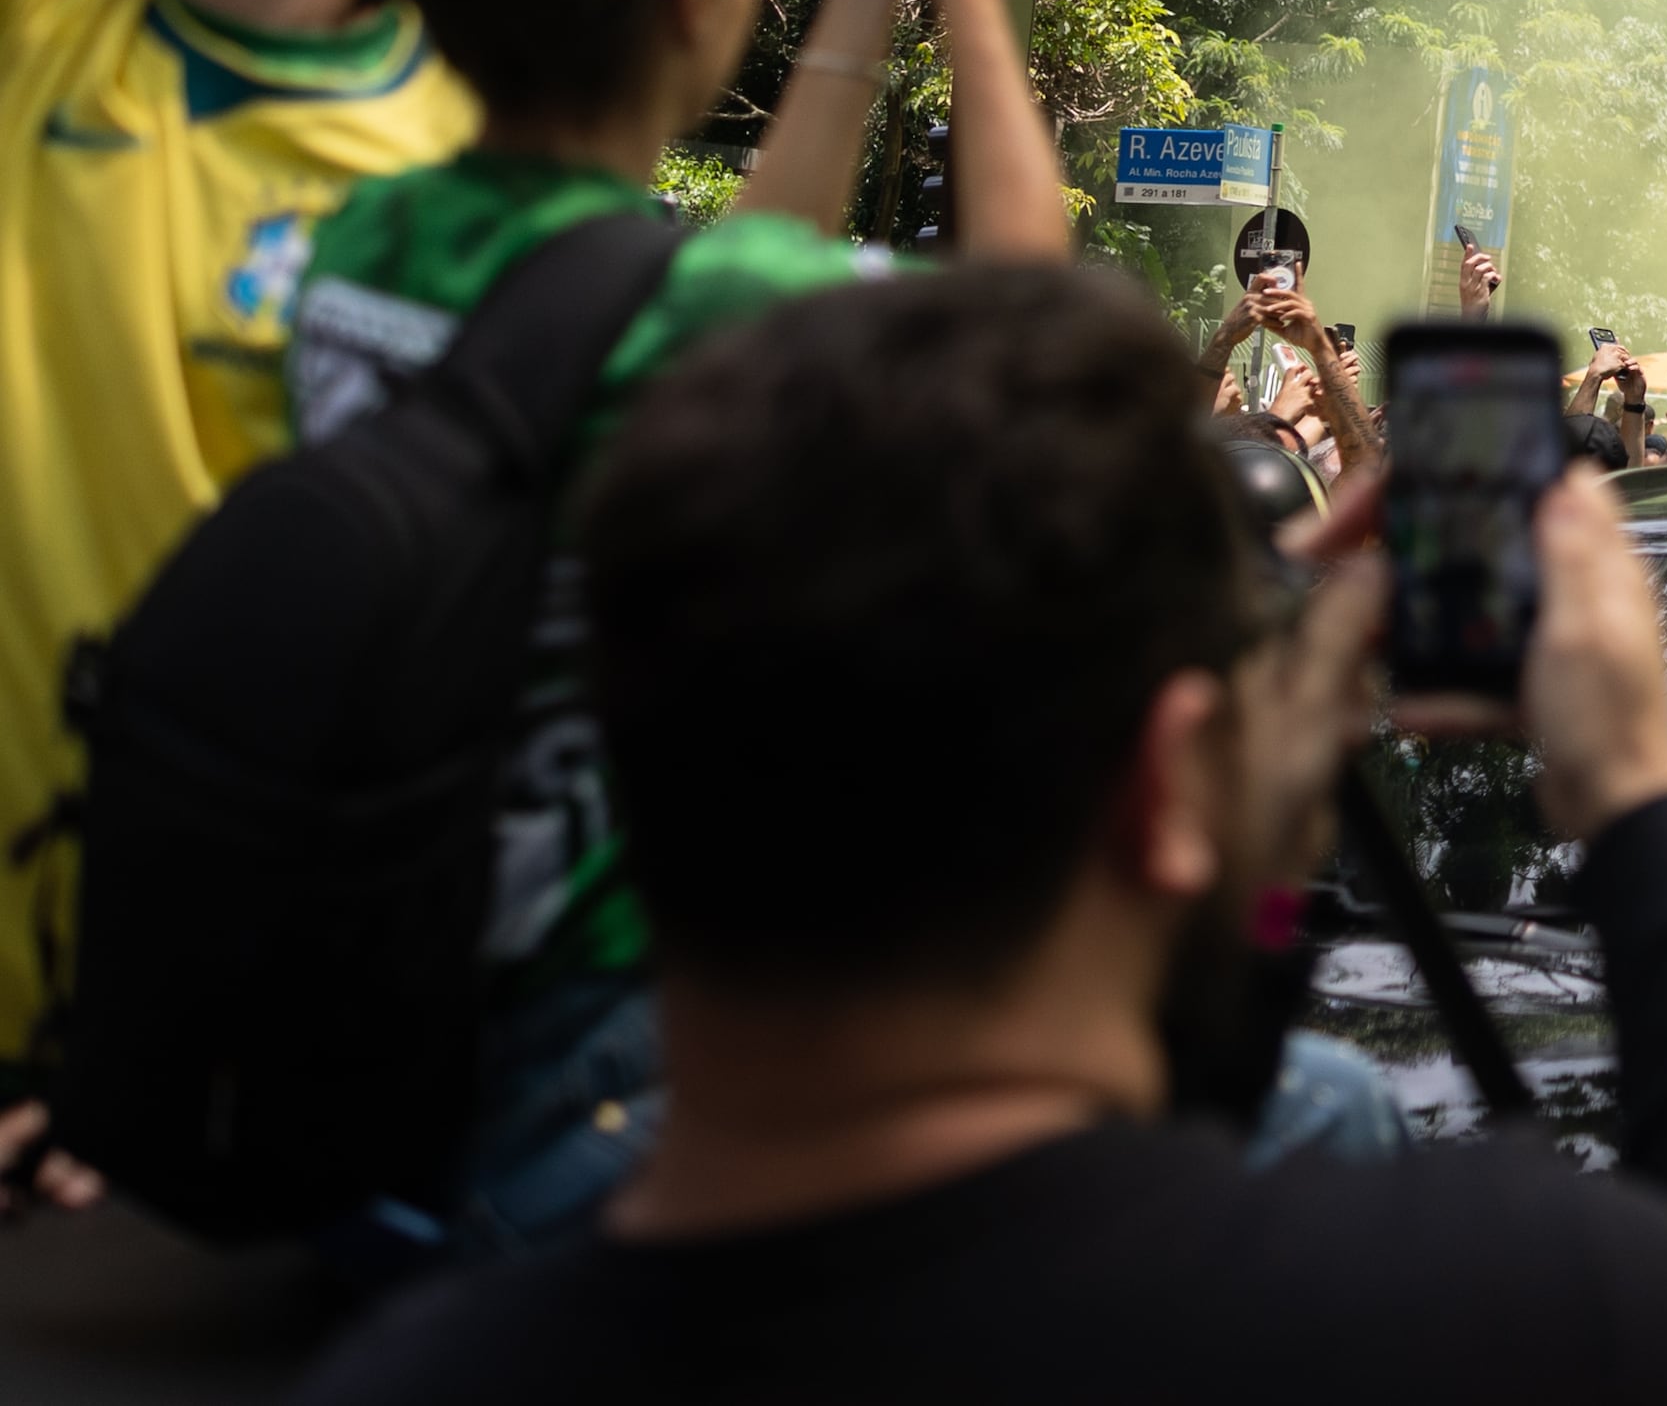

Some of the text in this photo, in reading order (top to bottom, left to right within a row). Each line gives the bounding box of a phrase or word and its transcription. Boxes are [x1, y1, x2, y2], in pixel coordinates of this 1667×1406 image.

[1129, 134, 1151, 160] R.
[1227, 129, 1261, 161] Paulista
[1143, 167, 1163, 178] Min.
[1166, 168, 1198, 179] Rocha
[1141, 188, 1158, 198] 291
[1171, 189, 1187, 198] 181
